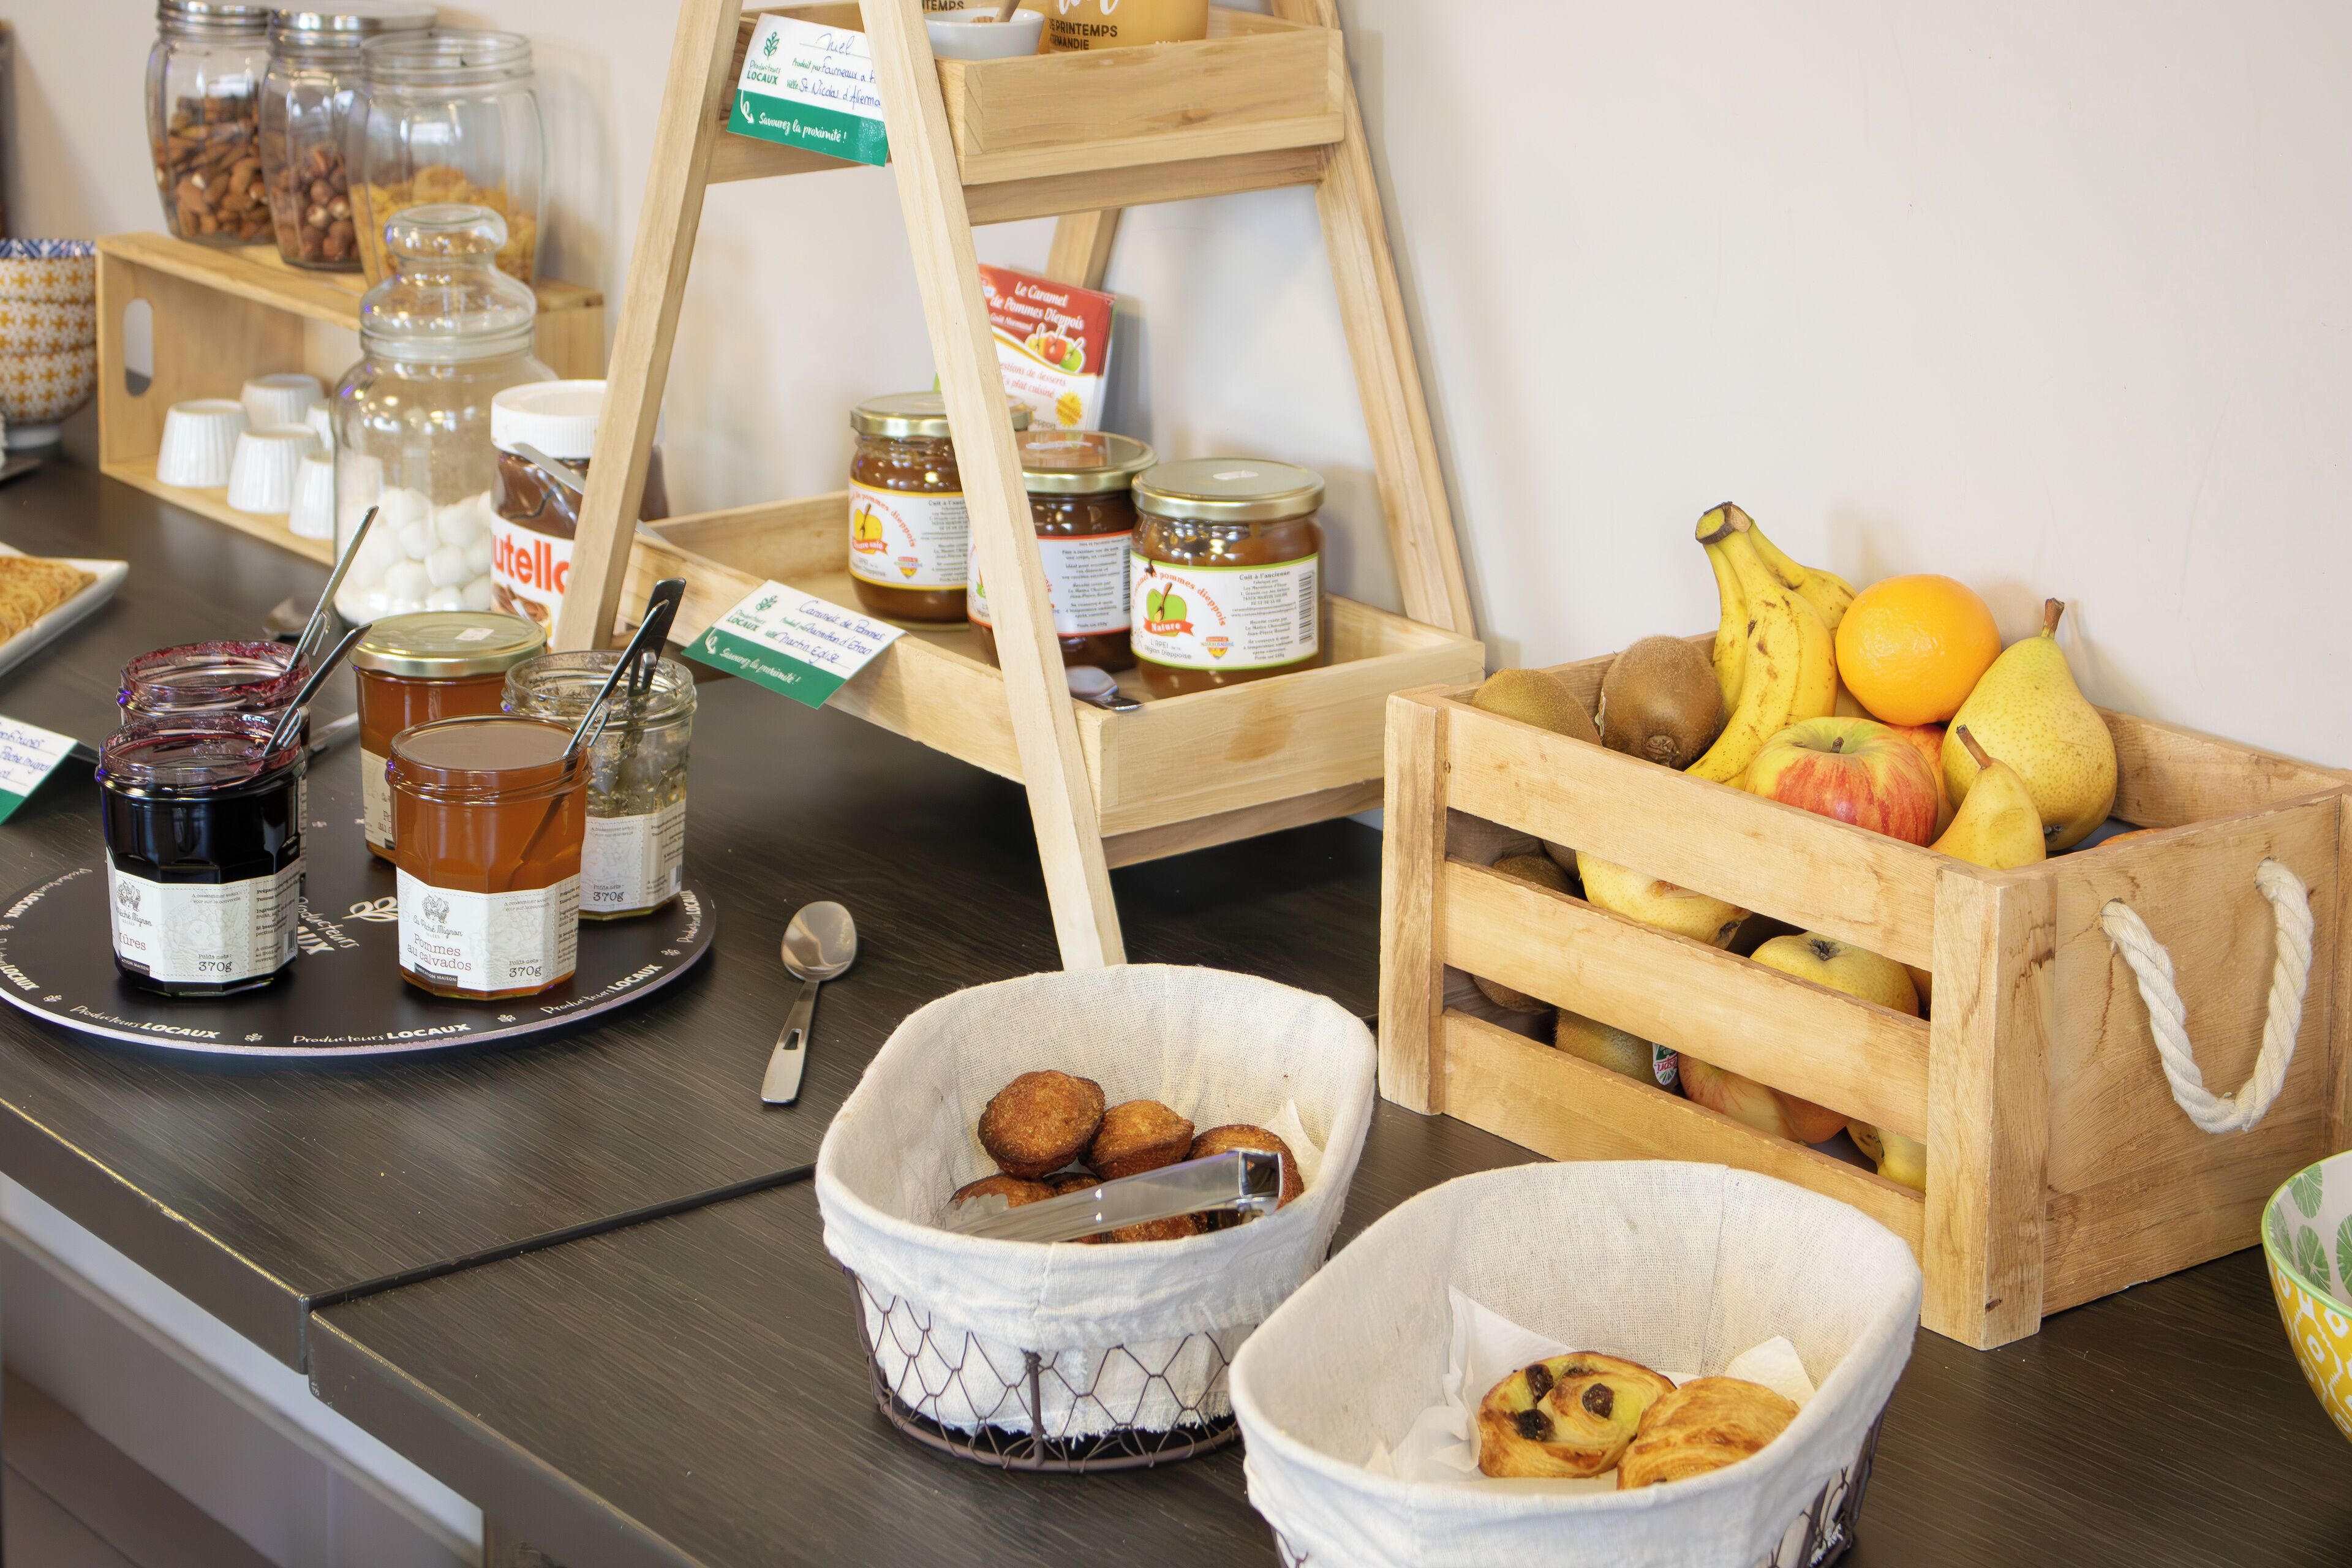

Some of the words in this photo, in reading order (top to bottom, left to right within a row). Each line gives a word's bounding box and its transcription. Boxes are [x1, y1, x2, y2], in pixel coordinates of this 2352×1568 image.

[1055, 20, 1117, 37] PRINTEMPS
[749, 59, 781, 74] Producteurs
[792, 58, 812, 69] Produit
[747, 70, 778, 85] LOCAUX
[758, 112, 791, 135] Savourez
[792, 119, 801, 134] la
[802, 125, 841, 142] proximité
[1014, 281, 1028, 298] Le
[1028, 284, 1068, 307] Caramel
[990, 295, 1003, 309] de
[1004, 296, 1043, 320] Pommes
[1044, 307, 1084, 331] Dieppois
[891, 511, 916, 548] dieppois
[1160, 572, 1196, 590] pommes
[1197, 588, 1226, 626] dieppois
[725, 616, 760, 631] LOCAUX
[1152, 622, 1182, 631] Nature
[777, 632, 810, 652] Martin
[809, 646, 839, 664] Eglise
[720, 648, 751, 669] Savourez
[593, 891, 624, 902] 370g
[679, 889, 702, 917] LOCAUX
[132, 912, 152, 927] Mignon
[421, 919, 435, 933] Péché
[437, 925, 462, 938] Mignon
[119, 932, 146, 951] ûres
[414, 933, 461, 957] Pommes
[134, 962, 149, 971] MAISON
[198, 961, 232, 973] 370g
[407, 944, 418, 957] au
[420, 952, 472, 971] calvados
[2, 965, 40, 990] LOCAUX
[510, 966, 542, 978] 370g
[540, 987, 615, 1014] Producteurs
[607, 963, 664, 992] LOCAUX
[70, 1005, 141, 1028] Producteurs
[140, 1022, 221, 1039] LOCAUX
[293, 1035, 384, 1043] Producteurs
[386, 1023, 472, 1040] LOCAUX
